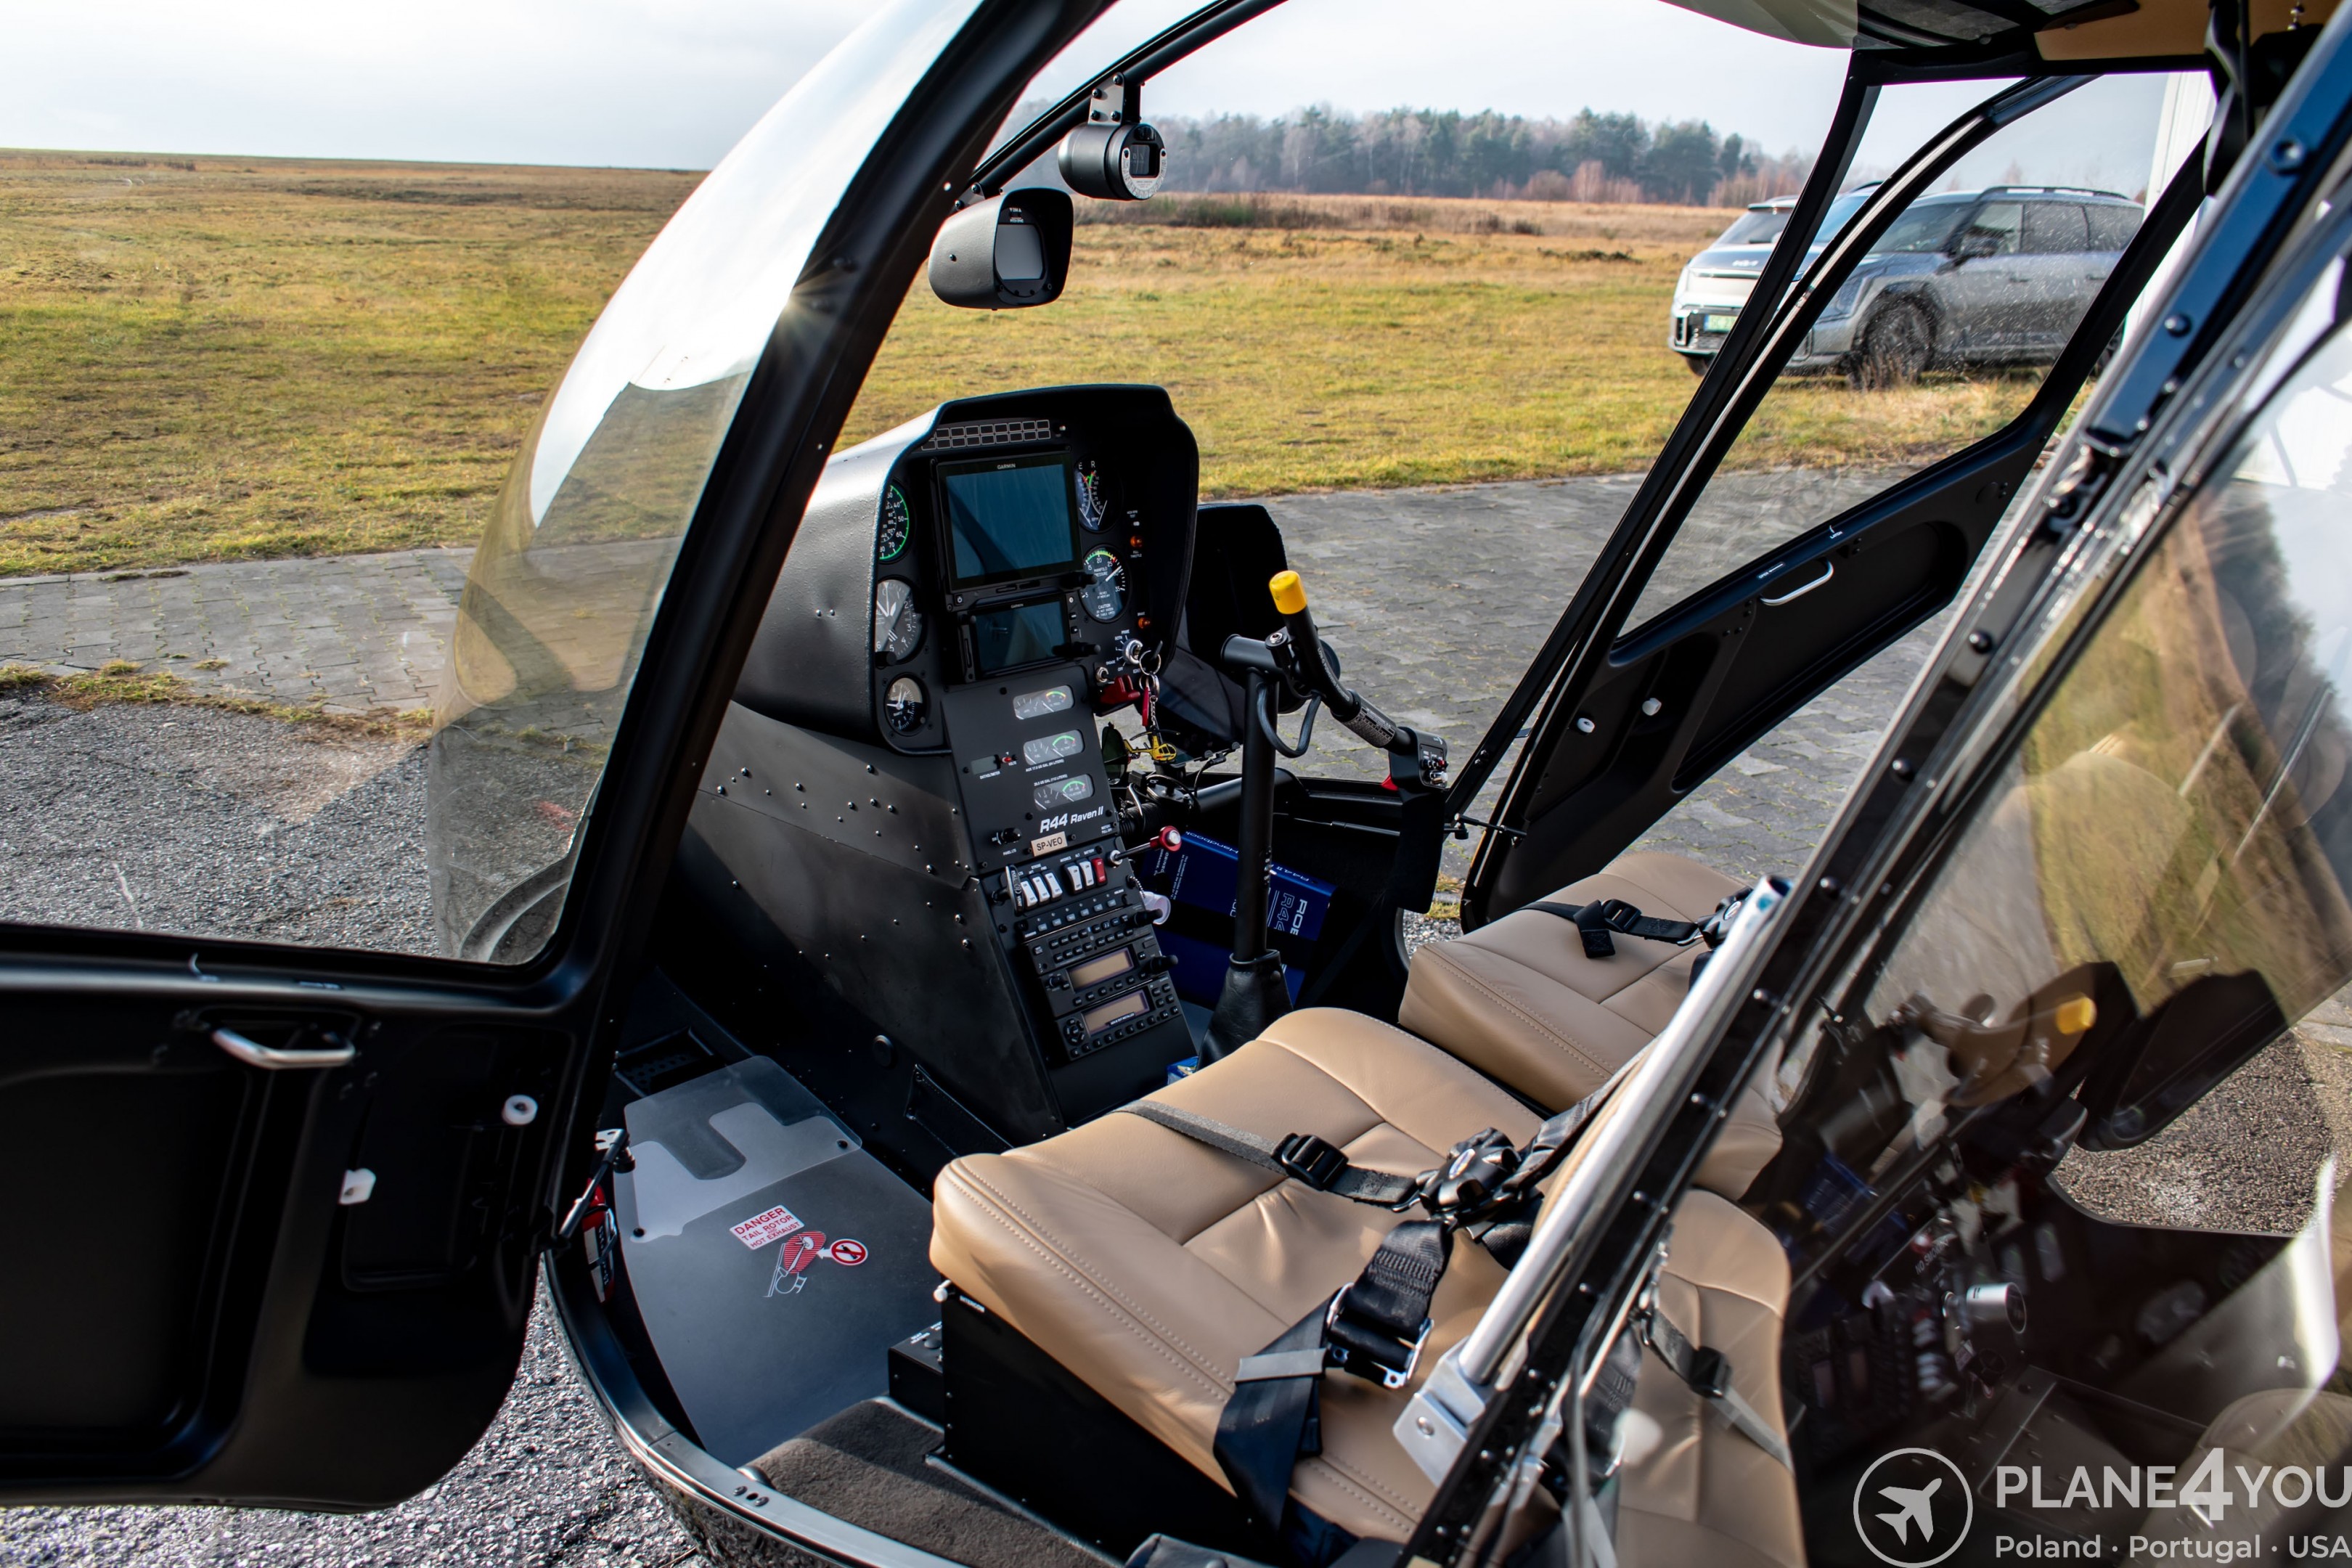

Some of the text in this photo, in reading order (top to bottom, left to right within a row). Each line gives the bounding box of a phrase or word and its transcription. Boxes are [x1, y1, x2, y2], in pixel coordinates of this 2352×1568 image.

[1040, 806, 1103, 833] R44 Raven II
[1037, 836, 1063, 852] SP-VEO
[1185, 830, 1238, 854] Handbook
[735, 1207, 786, 1235] DANGER
[742, 1214, 793, 1241] TAIL ROTOR
[751, 1222, 800, 1248] HOT EXHAUST
